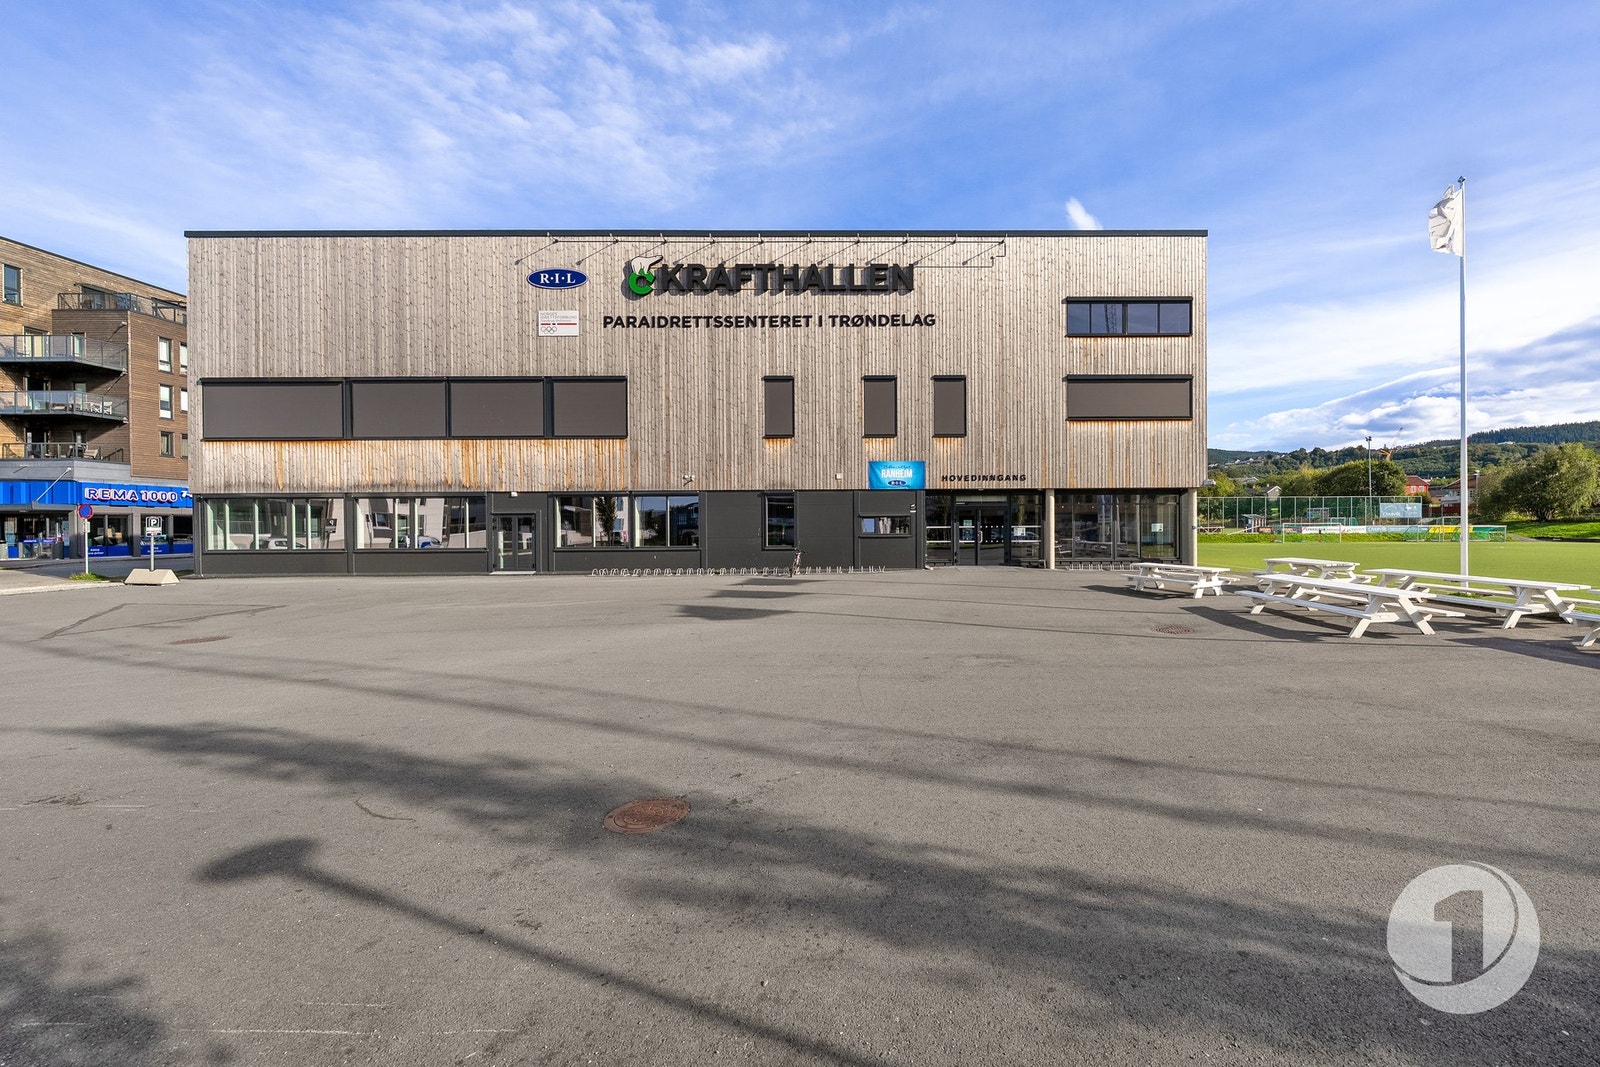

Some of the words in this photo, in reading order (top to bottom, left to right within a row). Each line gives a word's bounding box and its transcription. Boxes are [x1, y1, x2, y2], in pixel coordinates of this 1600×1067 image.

[661, 263, 915, 293] KRAFTHALLEN
[603, 315, 812, 329] PARAIDRETTSSENTERET
[818, 316, 823, 327] I
[828, 314, 936, 328] TRØNDELAG
[941, 474, 1027, 483] HOVEDINNGANG
[84, 487, 139, 501] REMA
[140, 490, 178, 503] 1000
